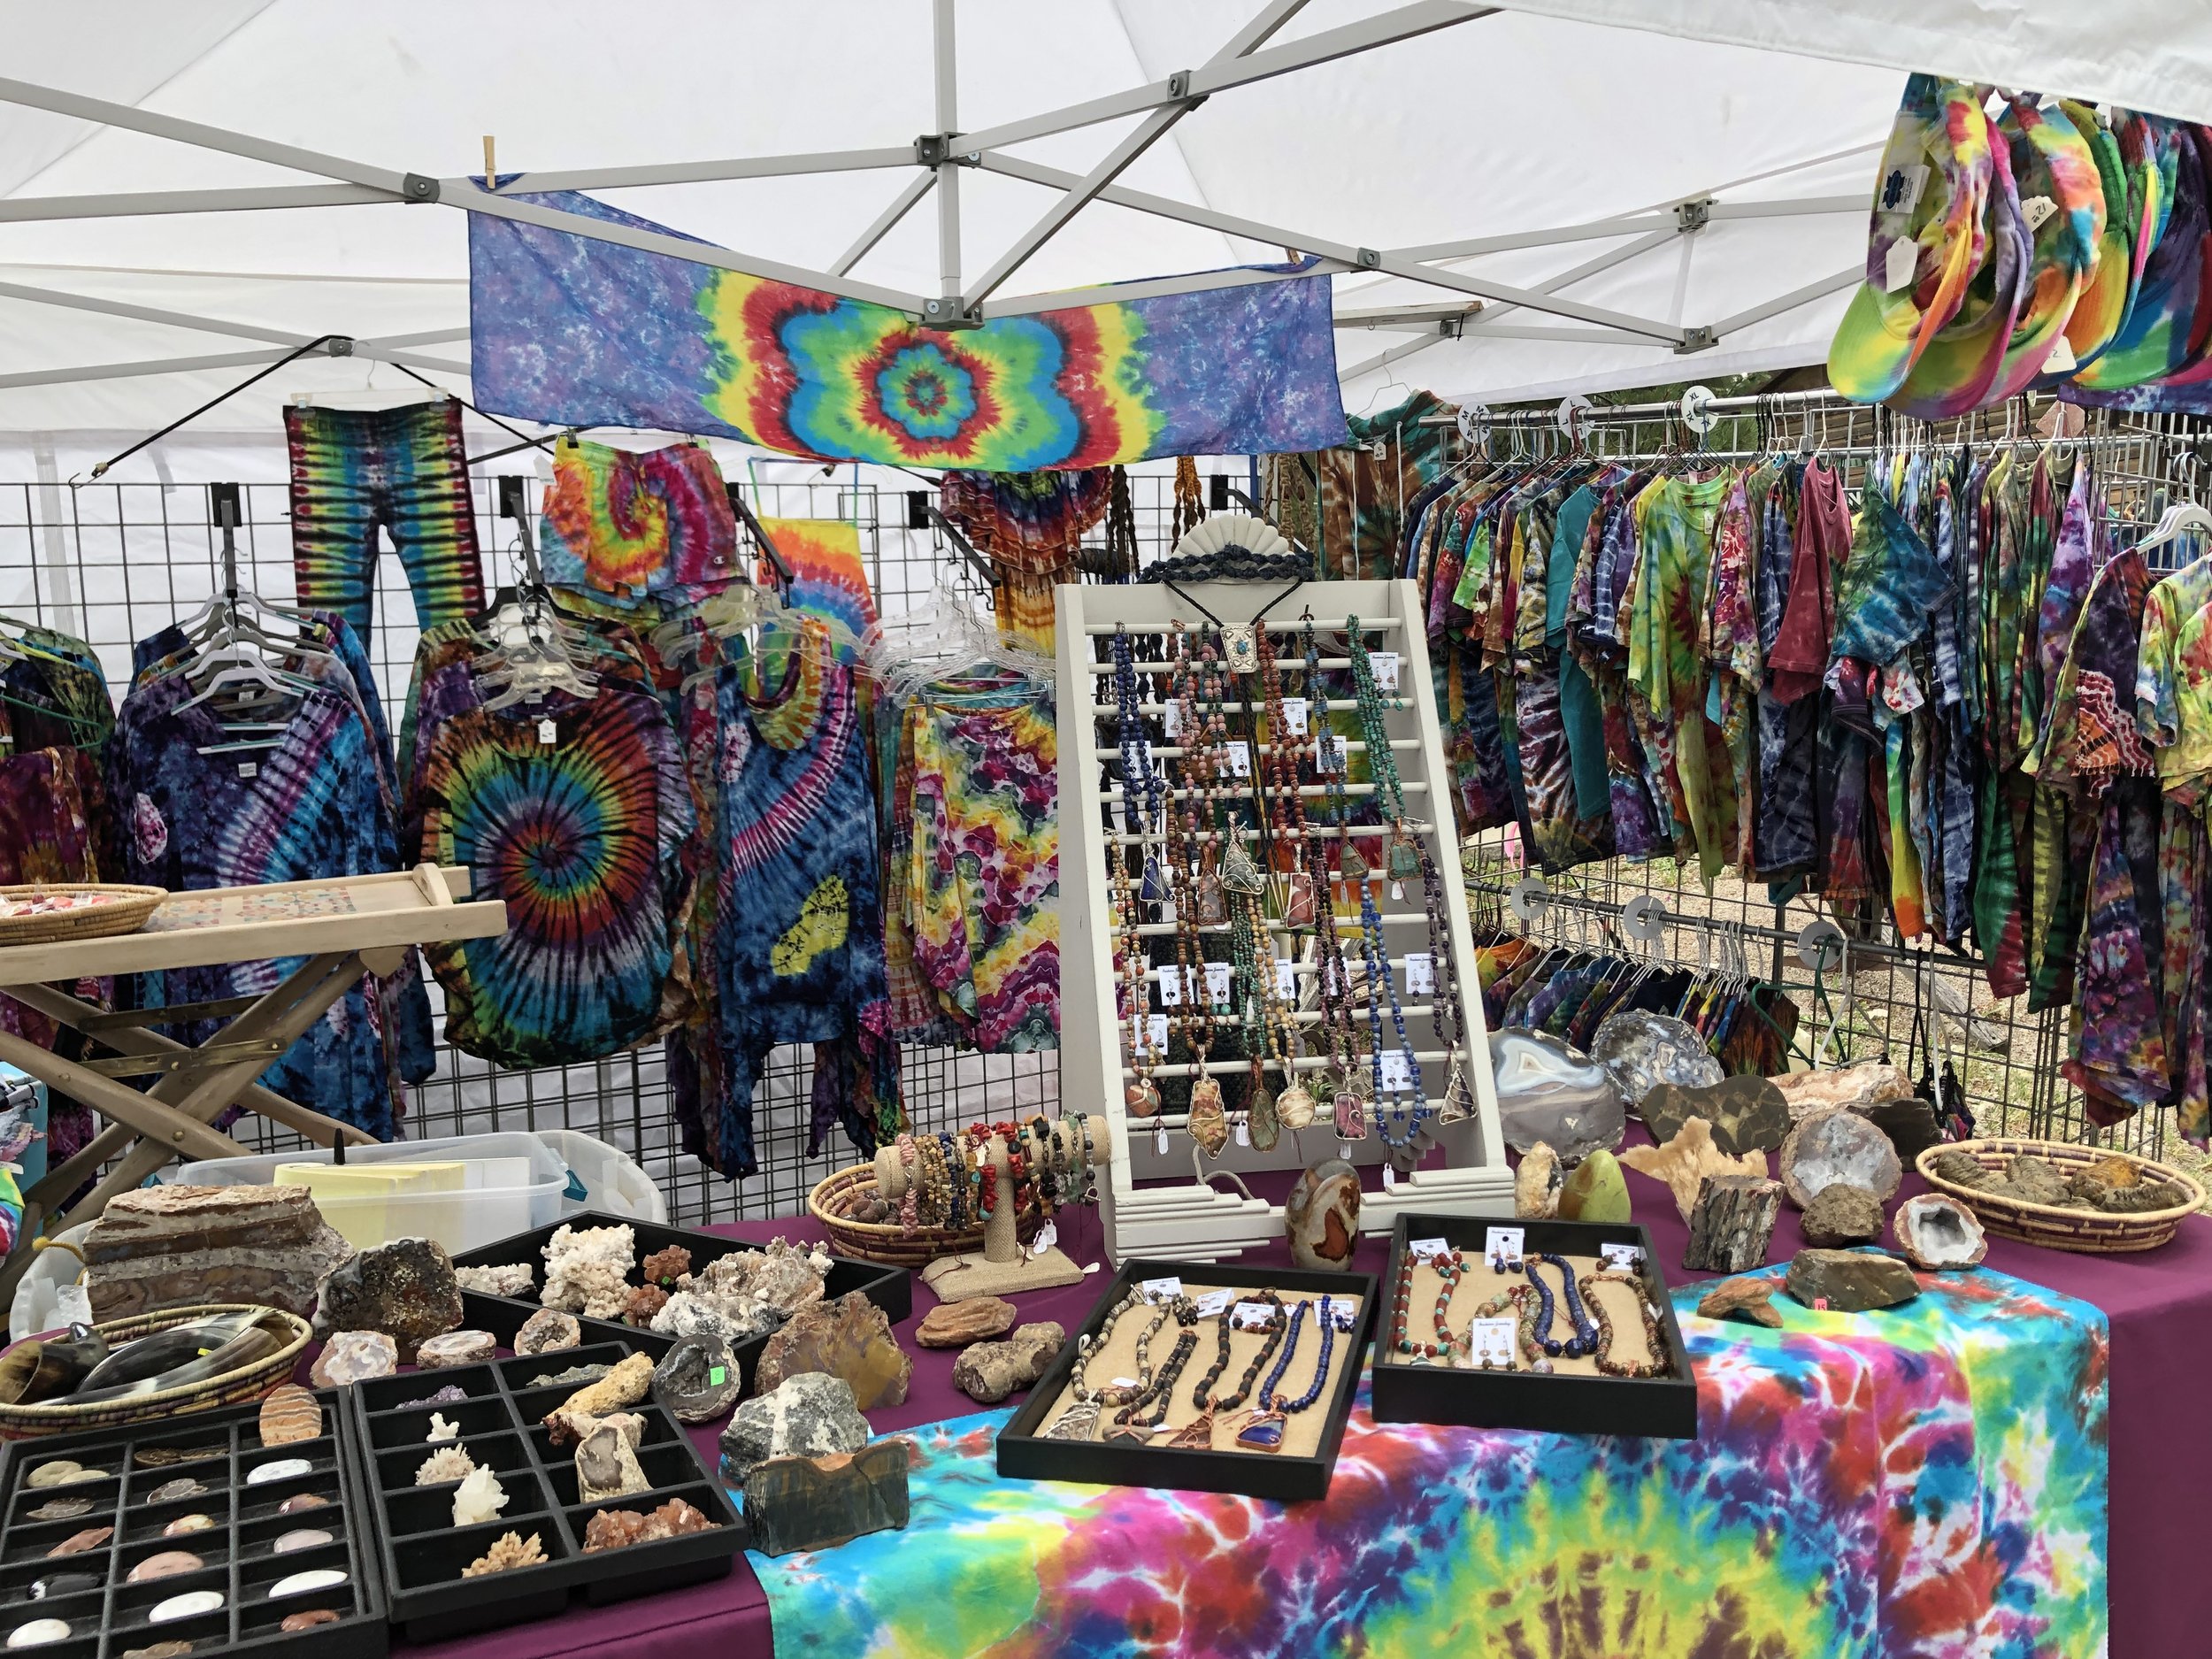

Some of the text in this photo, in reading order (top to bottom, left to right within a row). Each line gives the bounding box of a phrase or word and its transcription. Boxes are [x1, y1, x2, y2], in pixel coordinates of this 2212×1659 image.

[1689, 391, 1700, 402] XL
[1461, 410, 1470, 420] M
[1686, 411, 1694, 423] XL
